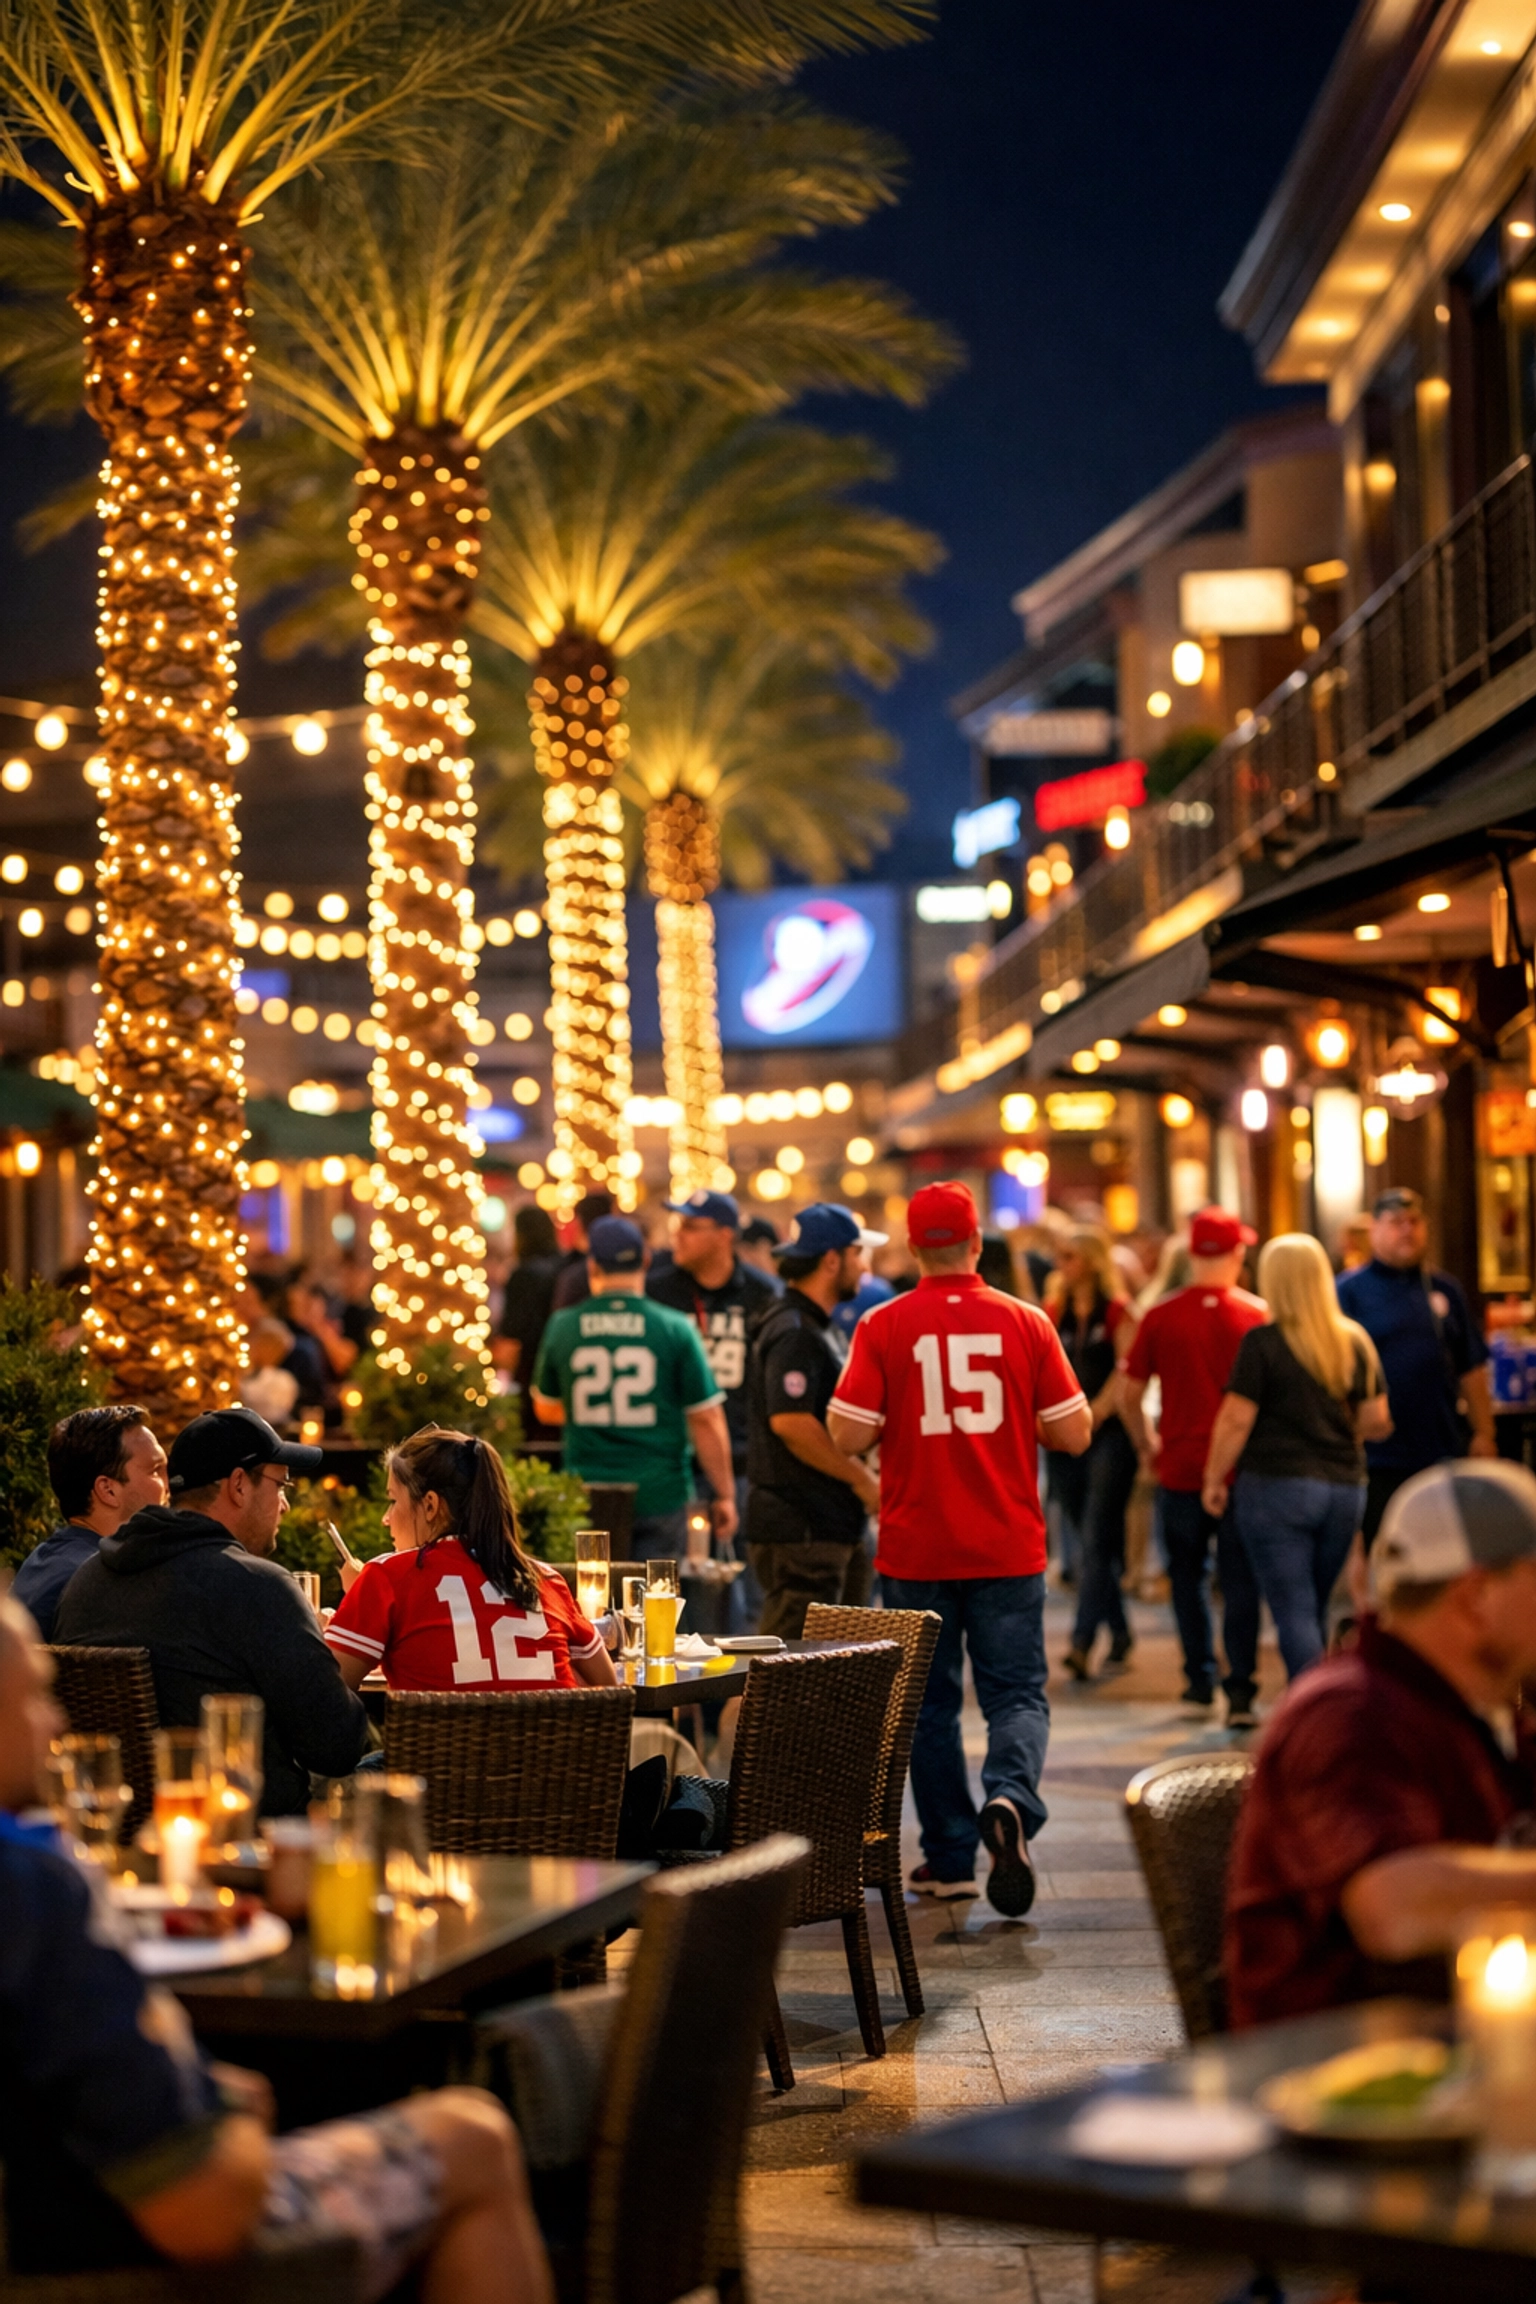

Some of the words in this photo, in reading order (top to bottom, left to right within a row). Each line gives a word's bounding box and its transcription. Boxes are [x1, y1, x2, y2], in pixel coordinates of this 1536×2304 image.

[570, 1346, 657, 1427] 22
[912, 1333, 1004, 1436] 15
[435, 1575, 556, 1684] 12
